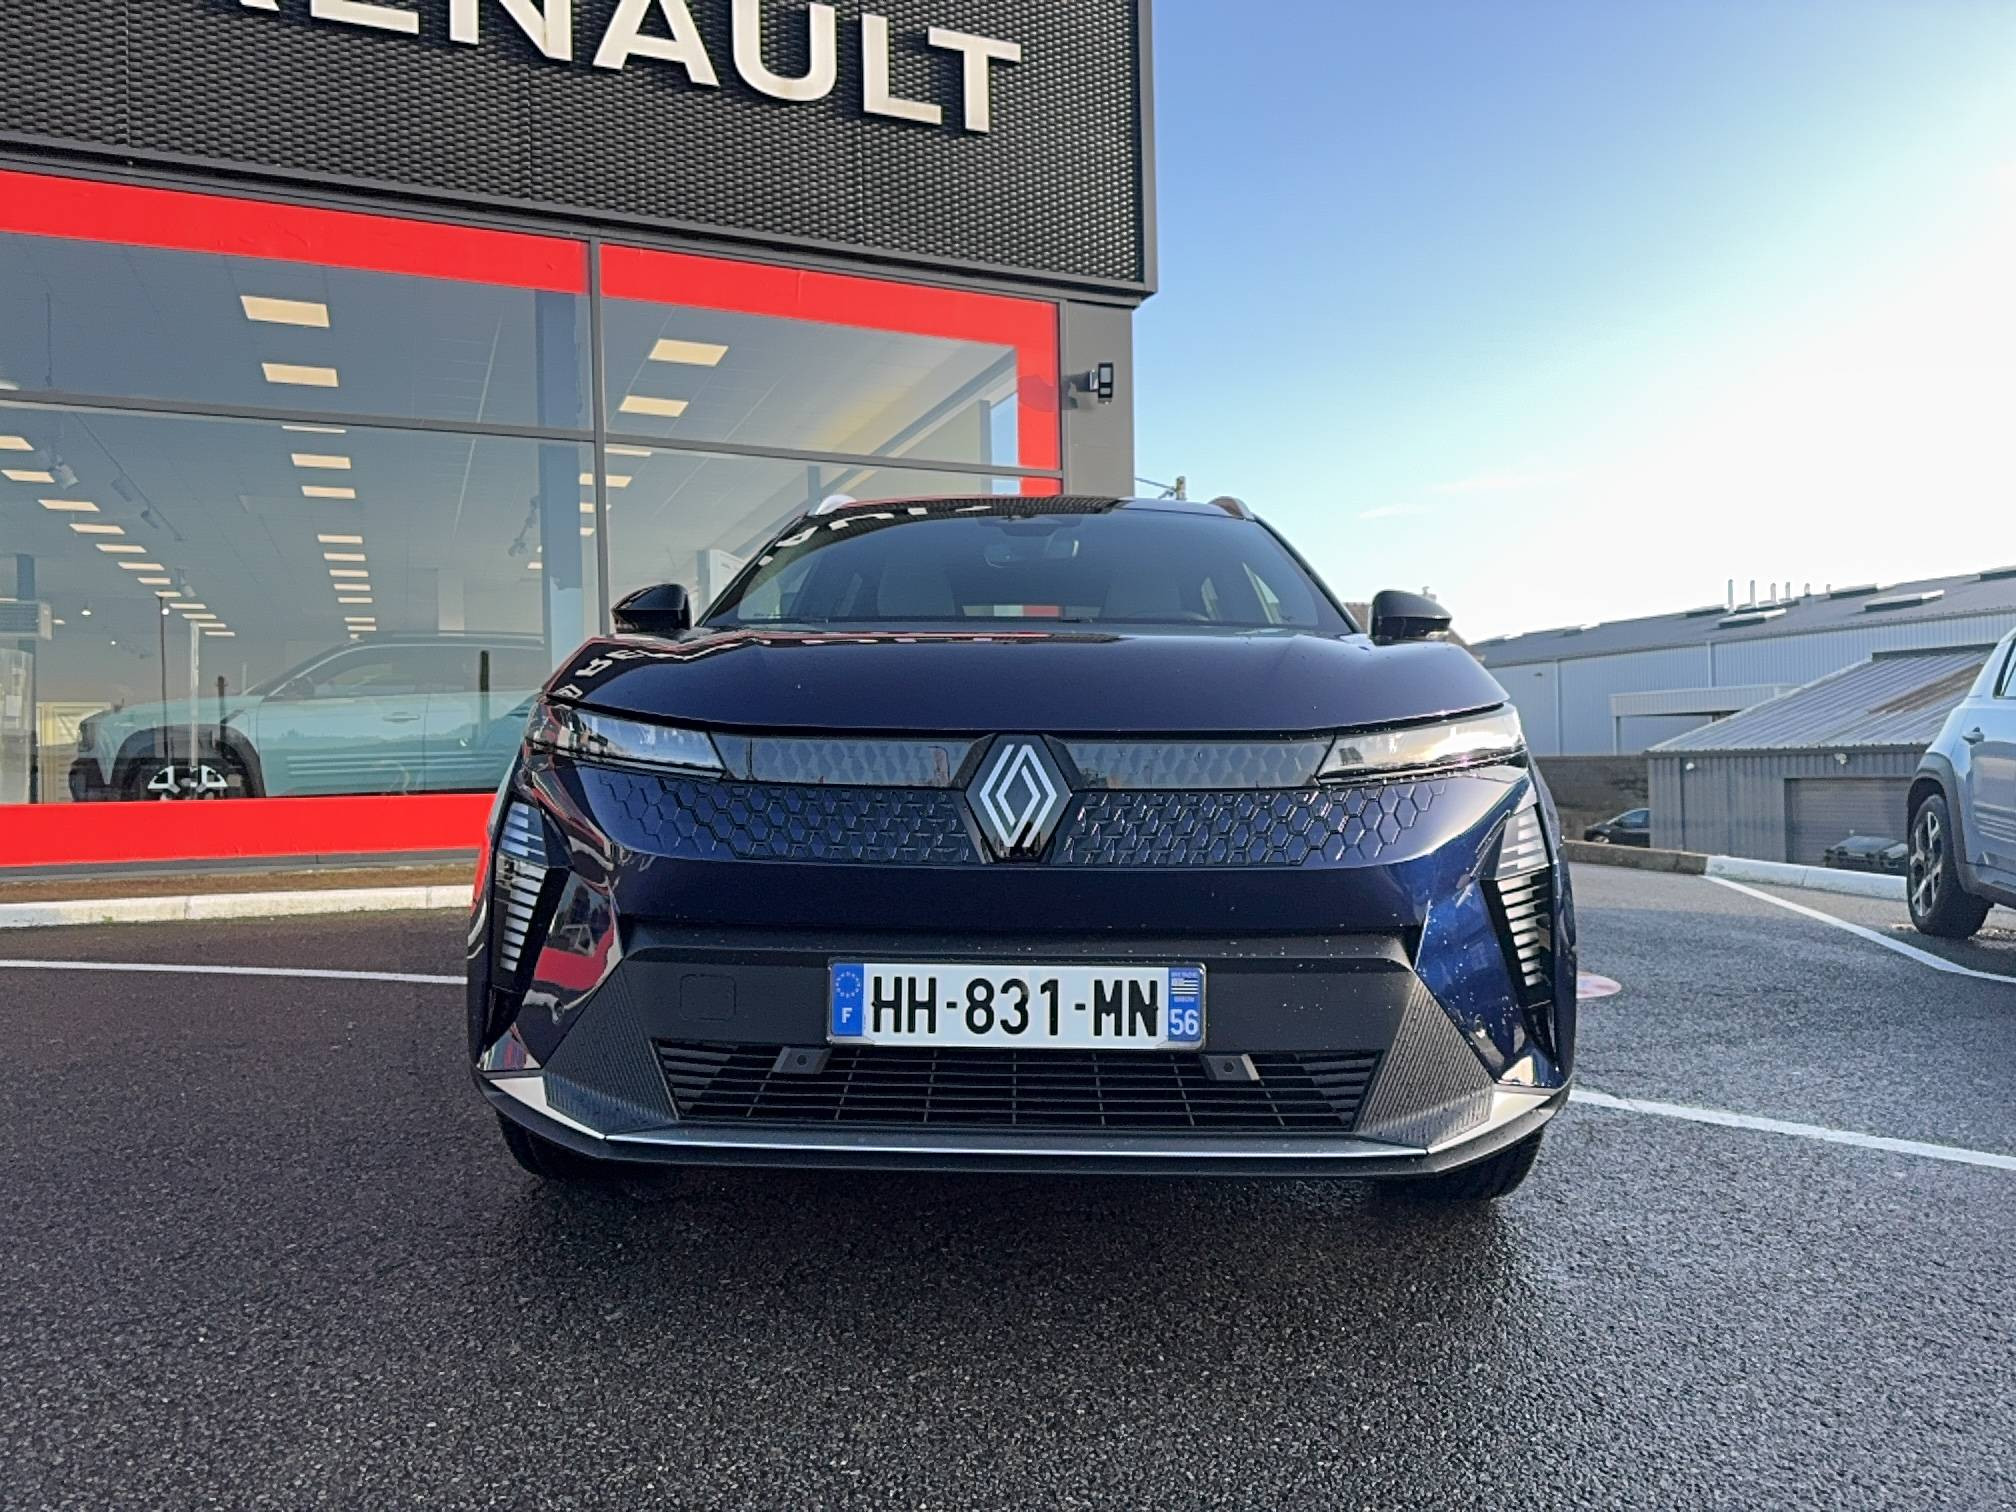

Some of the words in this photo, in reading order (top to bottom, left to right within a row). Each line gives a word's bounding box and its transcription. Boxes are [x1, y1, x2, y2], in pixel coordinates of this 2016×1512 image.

[238, 0, 1022, 133] NAULT
[841, 1007, 853, 1024] F
[872, 976, 1158, 1037] HH-831-MN
[1169, 1008, 1199, 1036] 56
